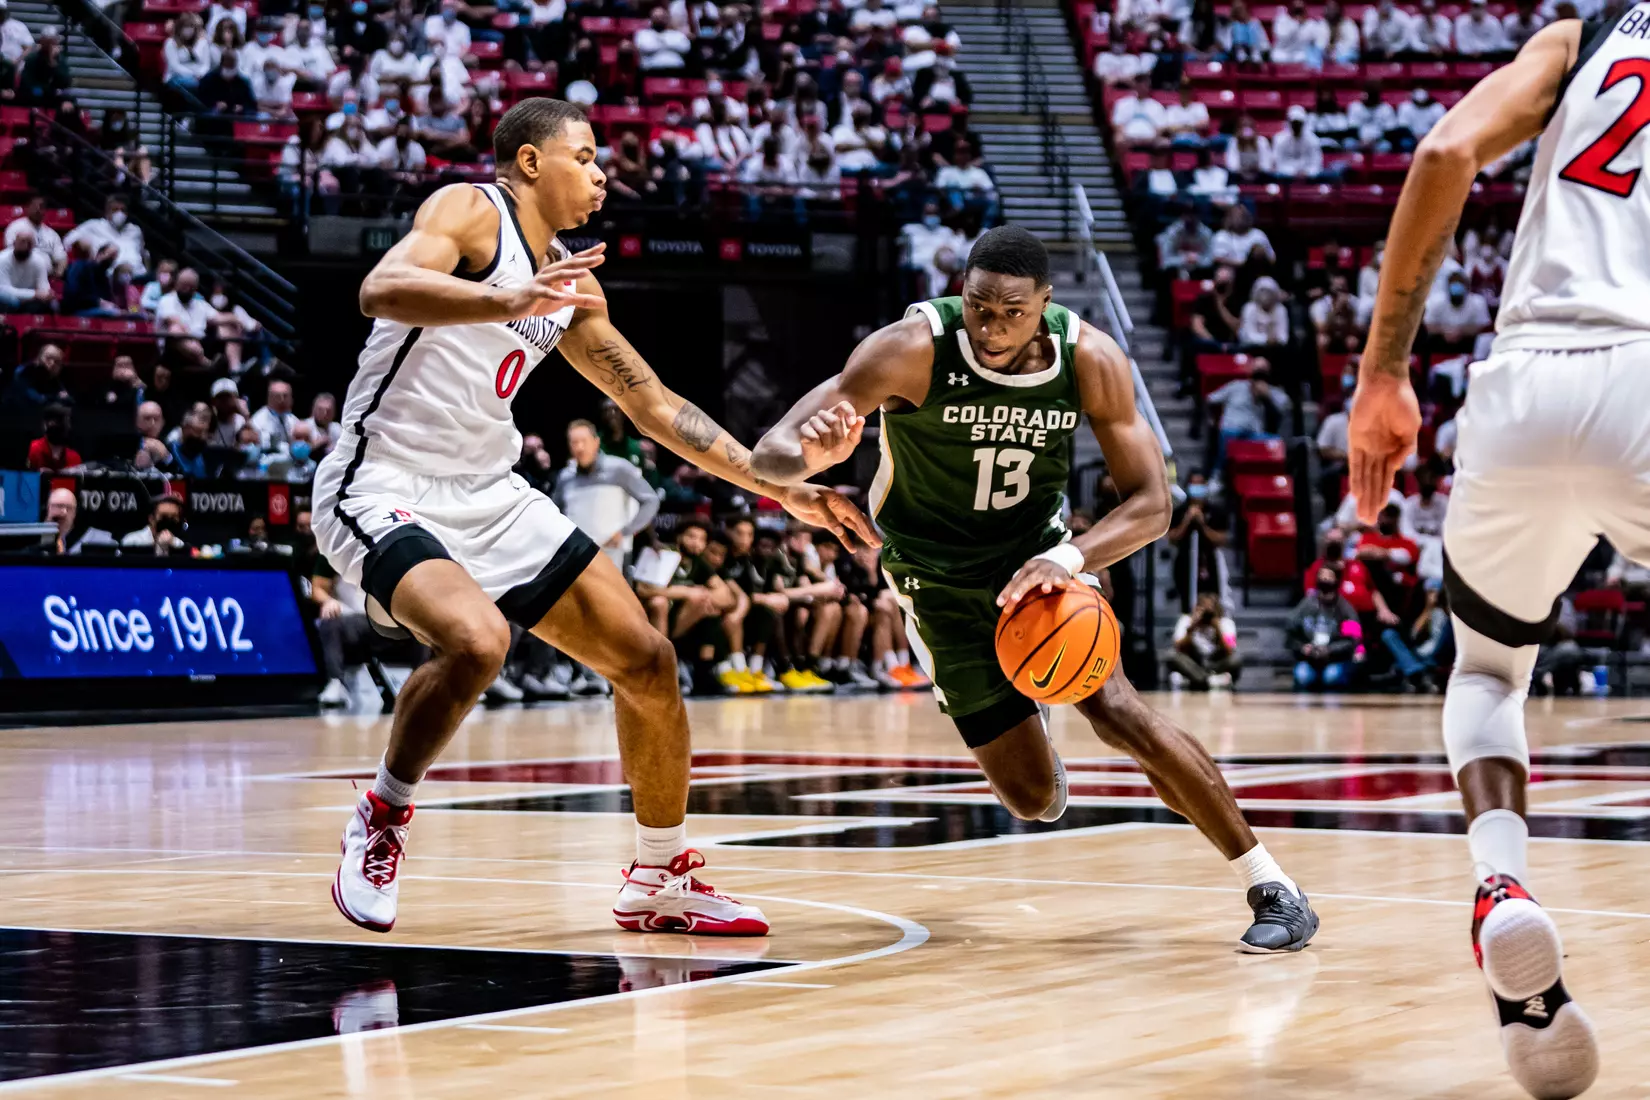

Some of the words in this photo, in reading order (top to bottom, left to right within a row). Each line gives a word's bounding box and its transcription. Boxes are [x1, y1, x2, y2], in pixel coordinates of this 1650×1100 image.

[1618, 9, 1650, 40] BA
[646, 238, 705, 255] TOYOTA
[746, 241, 803, 258] TOYOTA
[494, 348, 526, 400] 0
[942, 404, 1077, 430] COLORADO
[969, 423, 1048, 448] STATE
[972, 446, 1036, 512] 13
[191, 491, 246, 514] TOYOTA
[43, 594, 155, 653] Since
[159, 595, 253, 652] 1912
